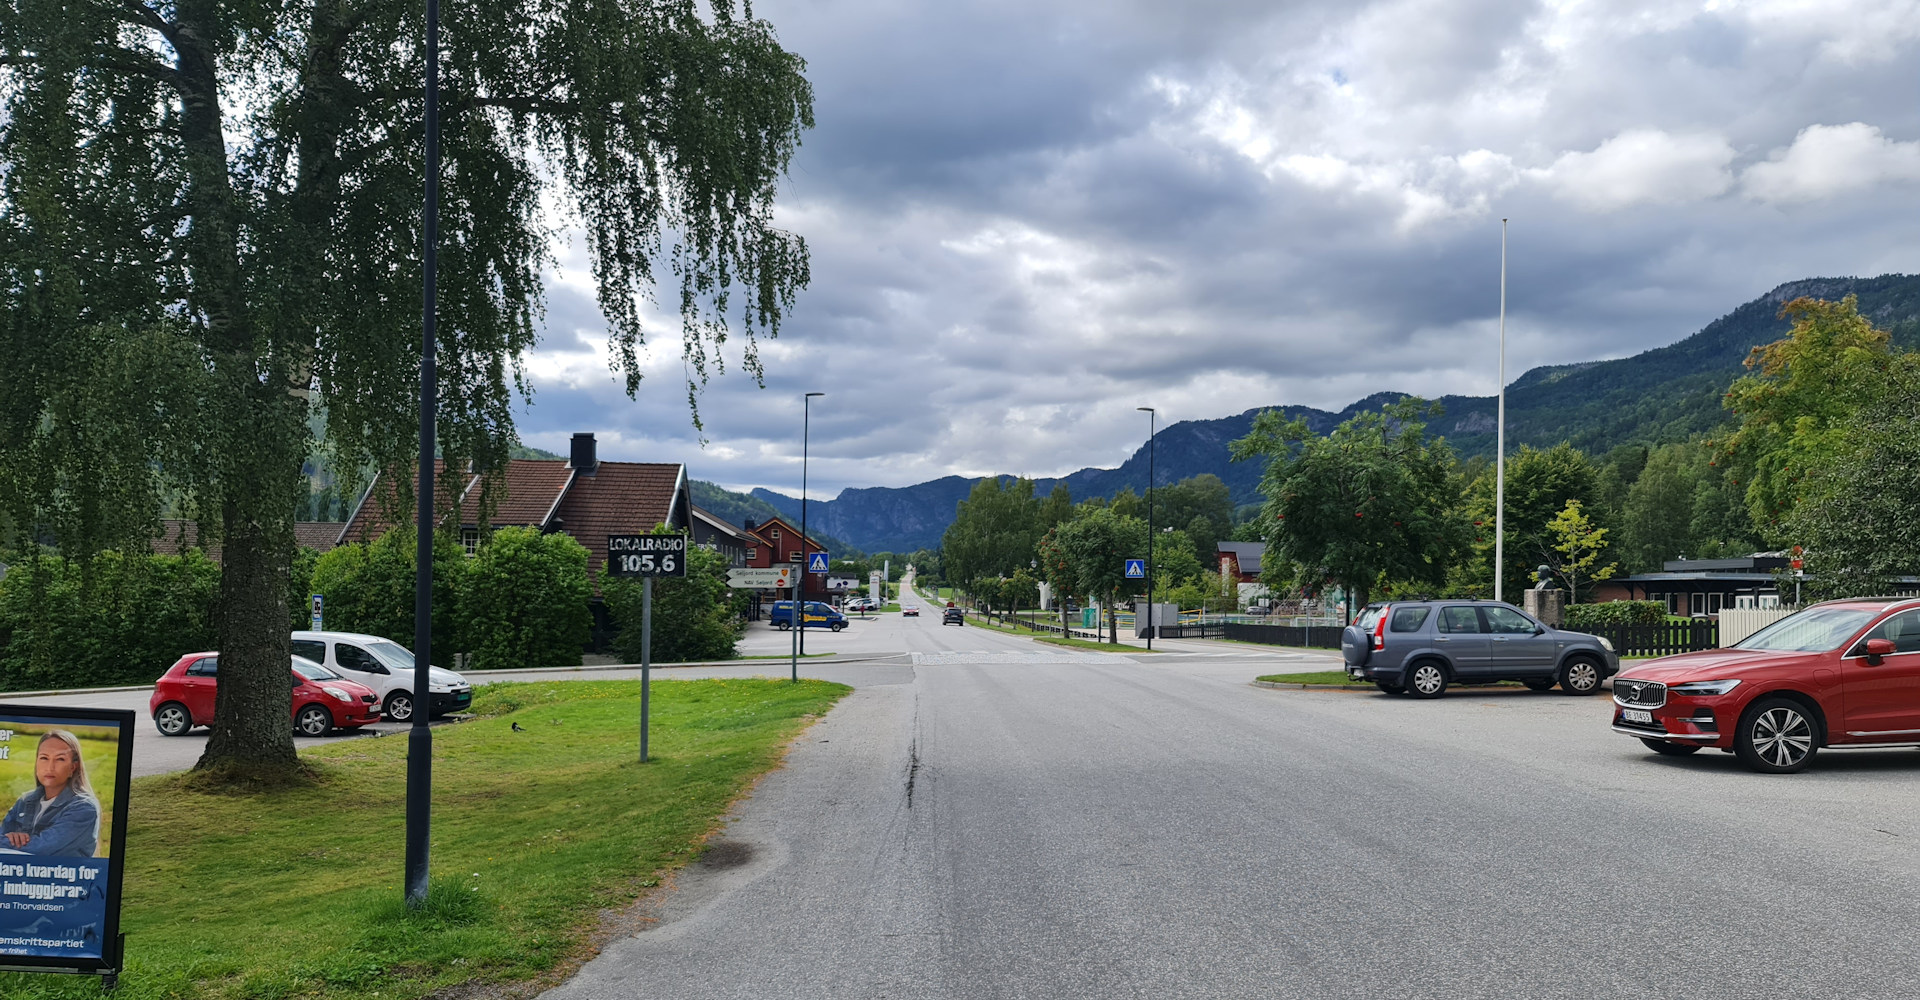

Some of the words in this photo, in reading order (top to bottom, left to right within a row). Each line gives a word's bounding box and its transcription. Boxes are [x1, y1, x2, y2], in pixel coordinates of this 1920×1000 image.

[609, 538, 683, 551] LOKALRADIO
[618, 554, 676, 573] 105,6
[26, 863, 77, 882] kvardag
[78, 865, 99, 880] for
[12, 901, 64, 911] Thorvaldsen
